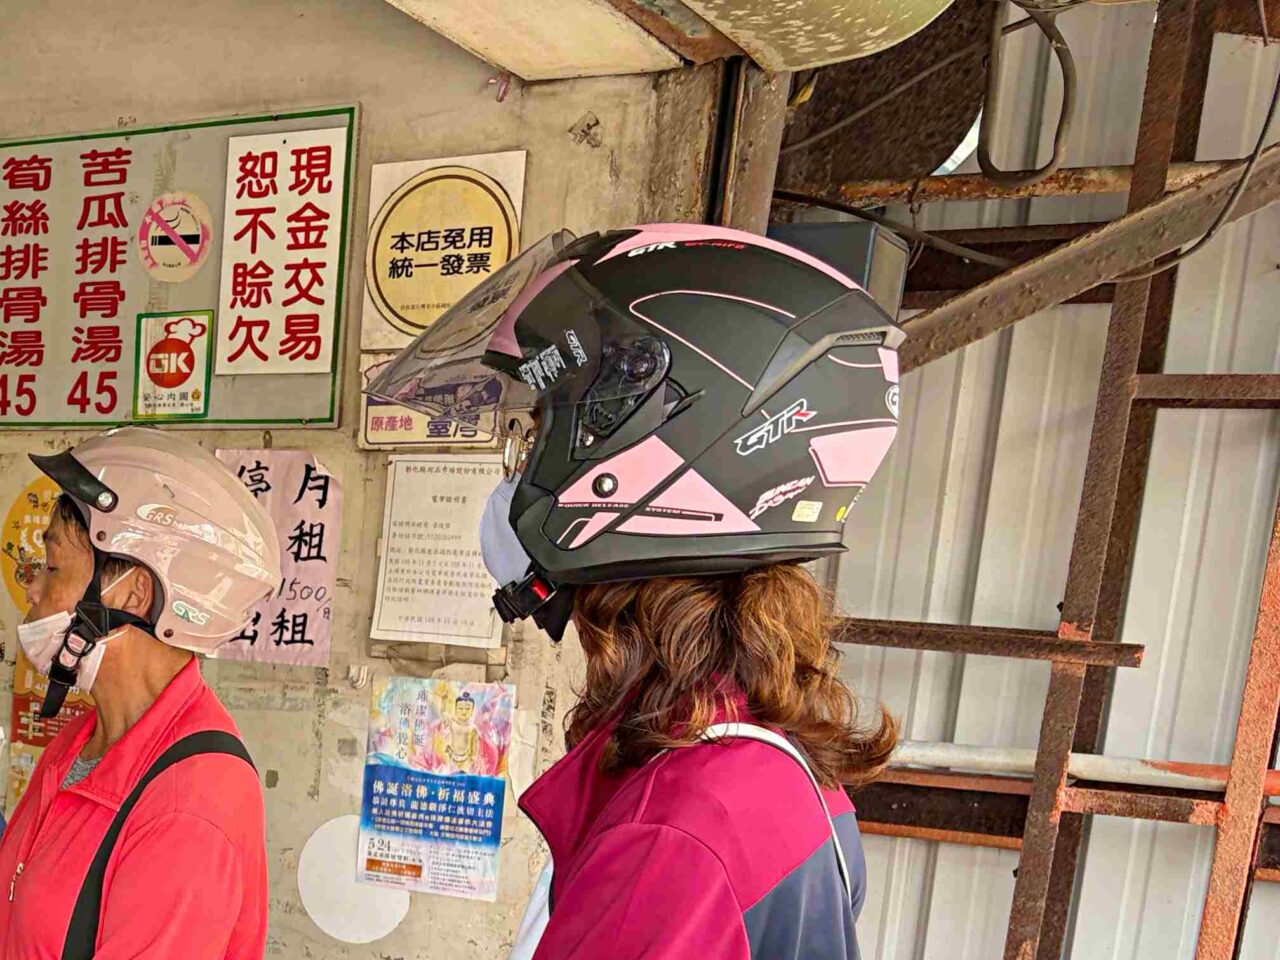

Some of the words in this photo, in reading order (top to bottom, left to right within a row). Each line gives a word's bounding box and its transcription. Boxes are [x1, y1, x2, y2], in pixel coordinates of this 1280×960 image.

[70, 147, 132, 364] 苦瓜排骨湯
[226, 150, 278, 363] 恕不賒欠
[278, 145, 333, 362] 現金交易
[388, 252, 492, 280] 統一發票
[389, 226, 493, 254] 本店免用
[66, 371, 118, 415] 45
[370, 415, 413, 433] 原產地
[734, 398, 818, 456] GTR
[287, 463, 329, 563] 月租
